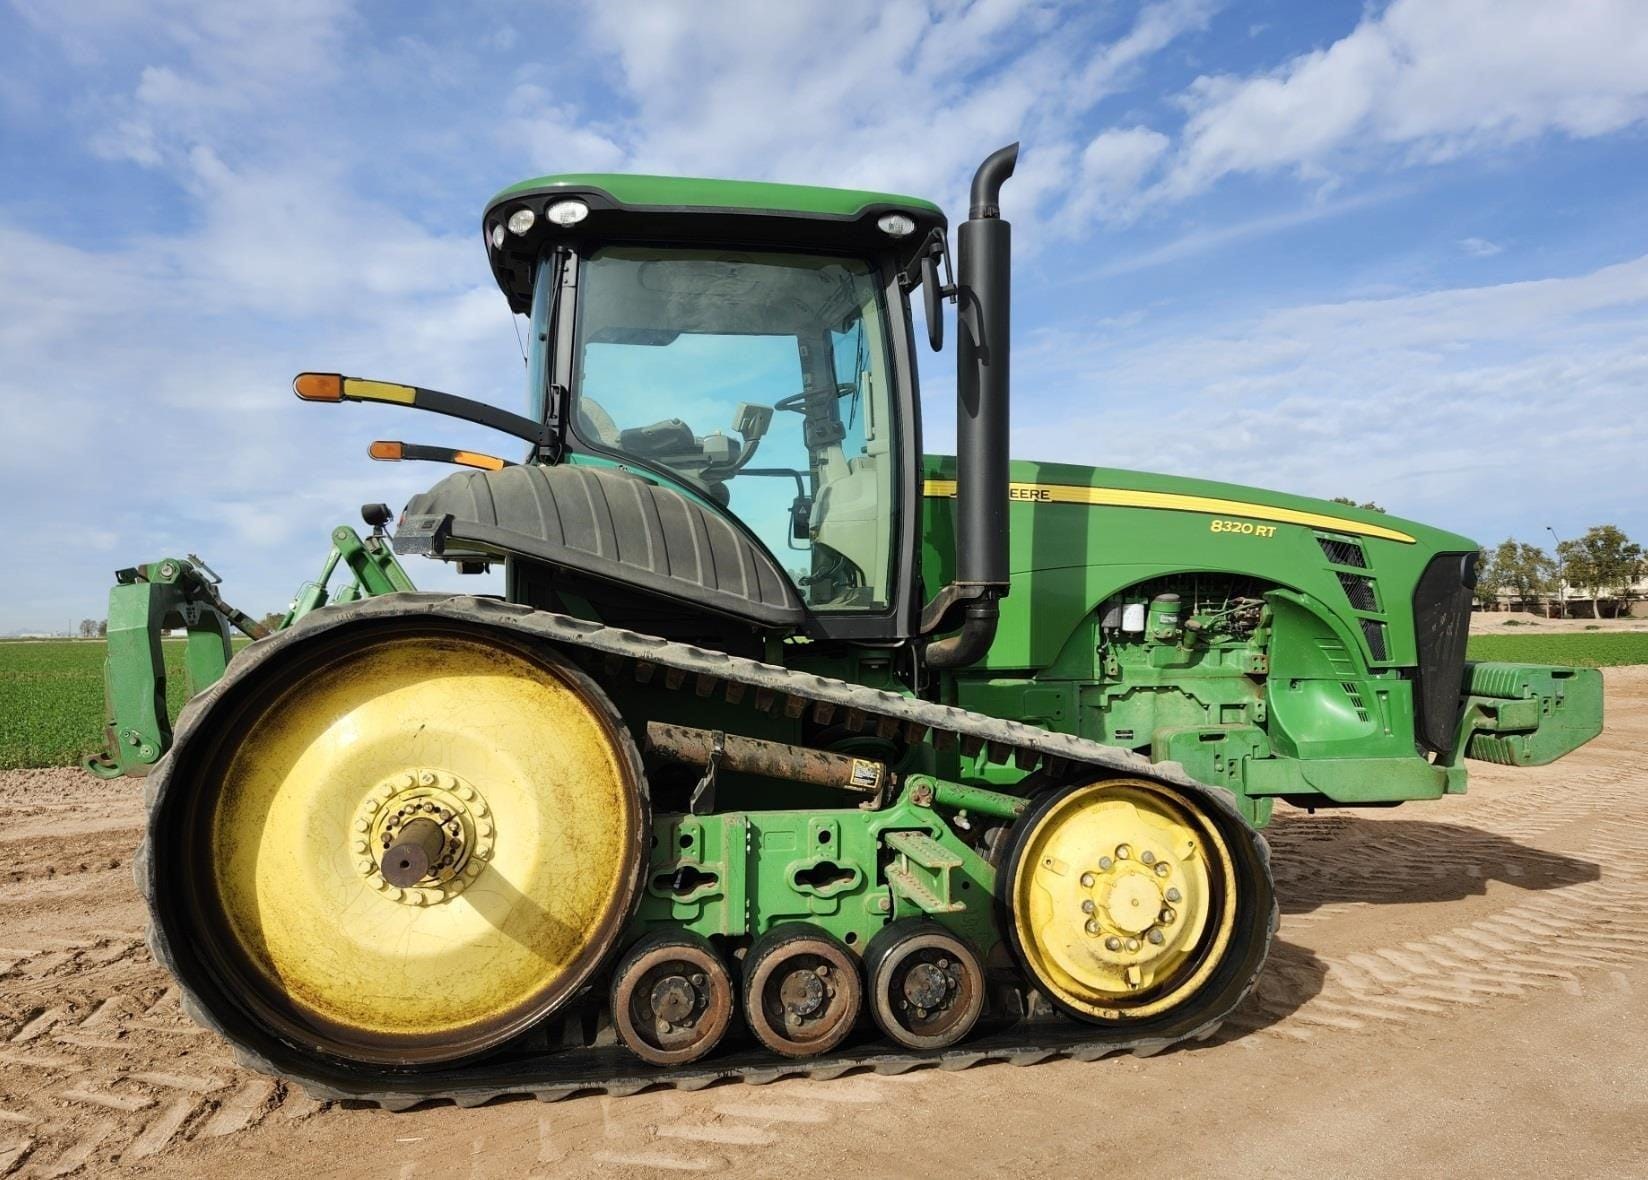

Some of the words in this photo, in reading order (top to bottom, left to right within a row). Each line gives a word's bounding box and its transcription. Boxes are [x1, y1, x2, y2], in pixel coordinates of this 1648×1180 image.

[1009, 488, 1050, 500] EERE
[1210, 519, 1253, 534] 8320
[1255, 525, 1277, 538] RT
